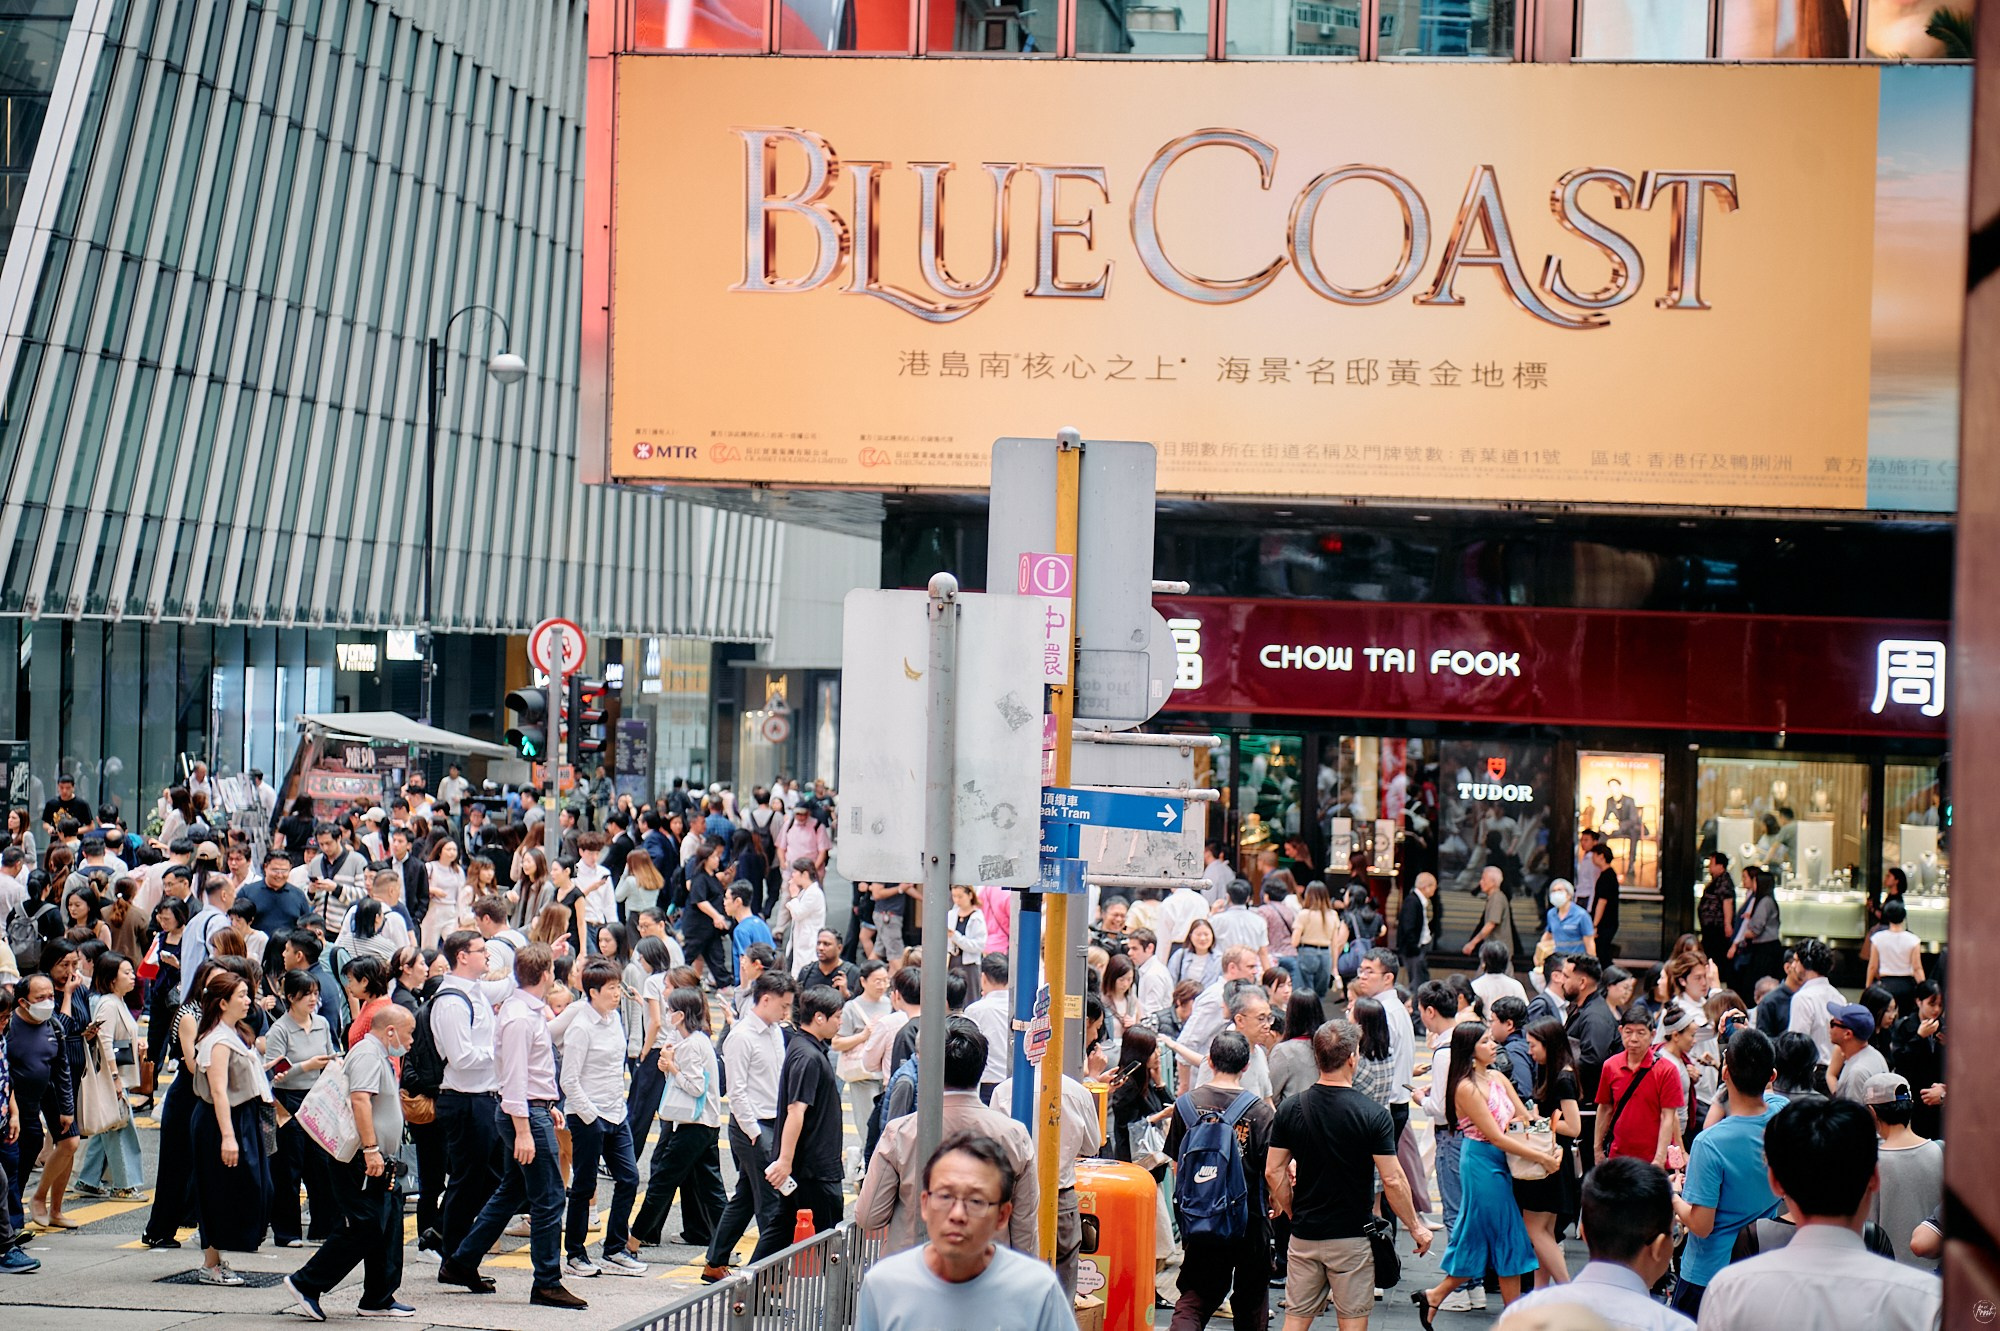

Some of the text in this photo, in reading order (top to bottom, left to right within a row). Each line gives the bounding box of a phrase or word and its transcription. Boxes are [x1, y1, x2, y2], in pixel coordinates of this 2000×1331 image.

[656, 445, 697, 459] MTR
[1044, 604, 1065, 676] 中環
[1259, 643, 1521, 678] CHOW TAI FOOK
[1870, 638, 1947, 717] 周
[1041, 793, 1079, 808] 頂纜車
[1457, 782, 1534, 803] TUDOR
[1040, 806, 1091, 820] eak Tram
